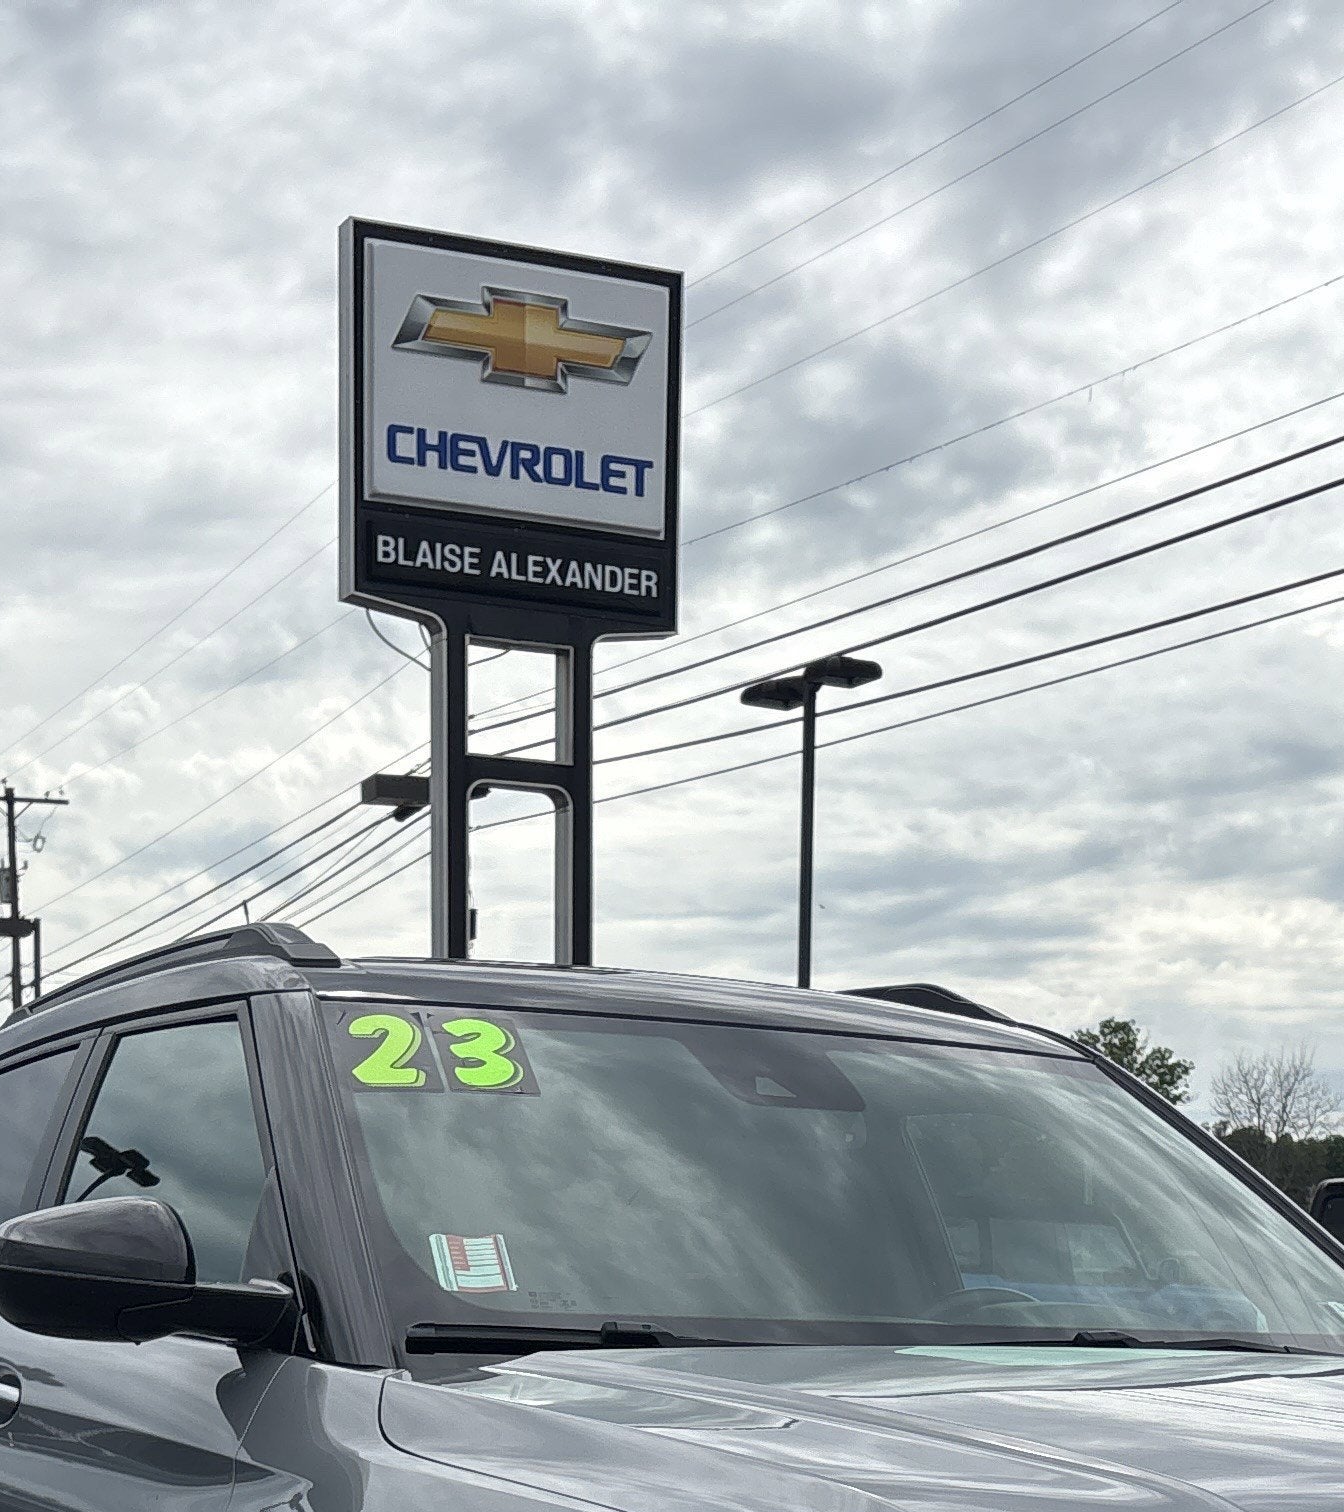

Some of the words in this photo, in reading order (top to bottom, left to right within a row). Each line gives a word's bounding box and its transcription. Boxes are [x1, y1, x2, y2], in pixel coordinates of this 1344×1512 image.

[386, 423, 654, 498] CHEVROLET
[376, 534, 482, 576] BLAISE
[489, 549, 659, 599] ALEXANDER
[348, 1014, 524, 1089] 23
